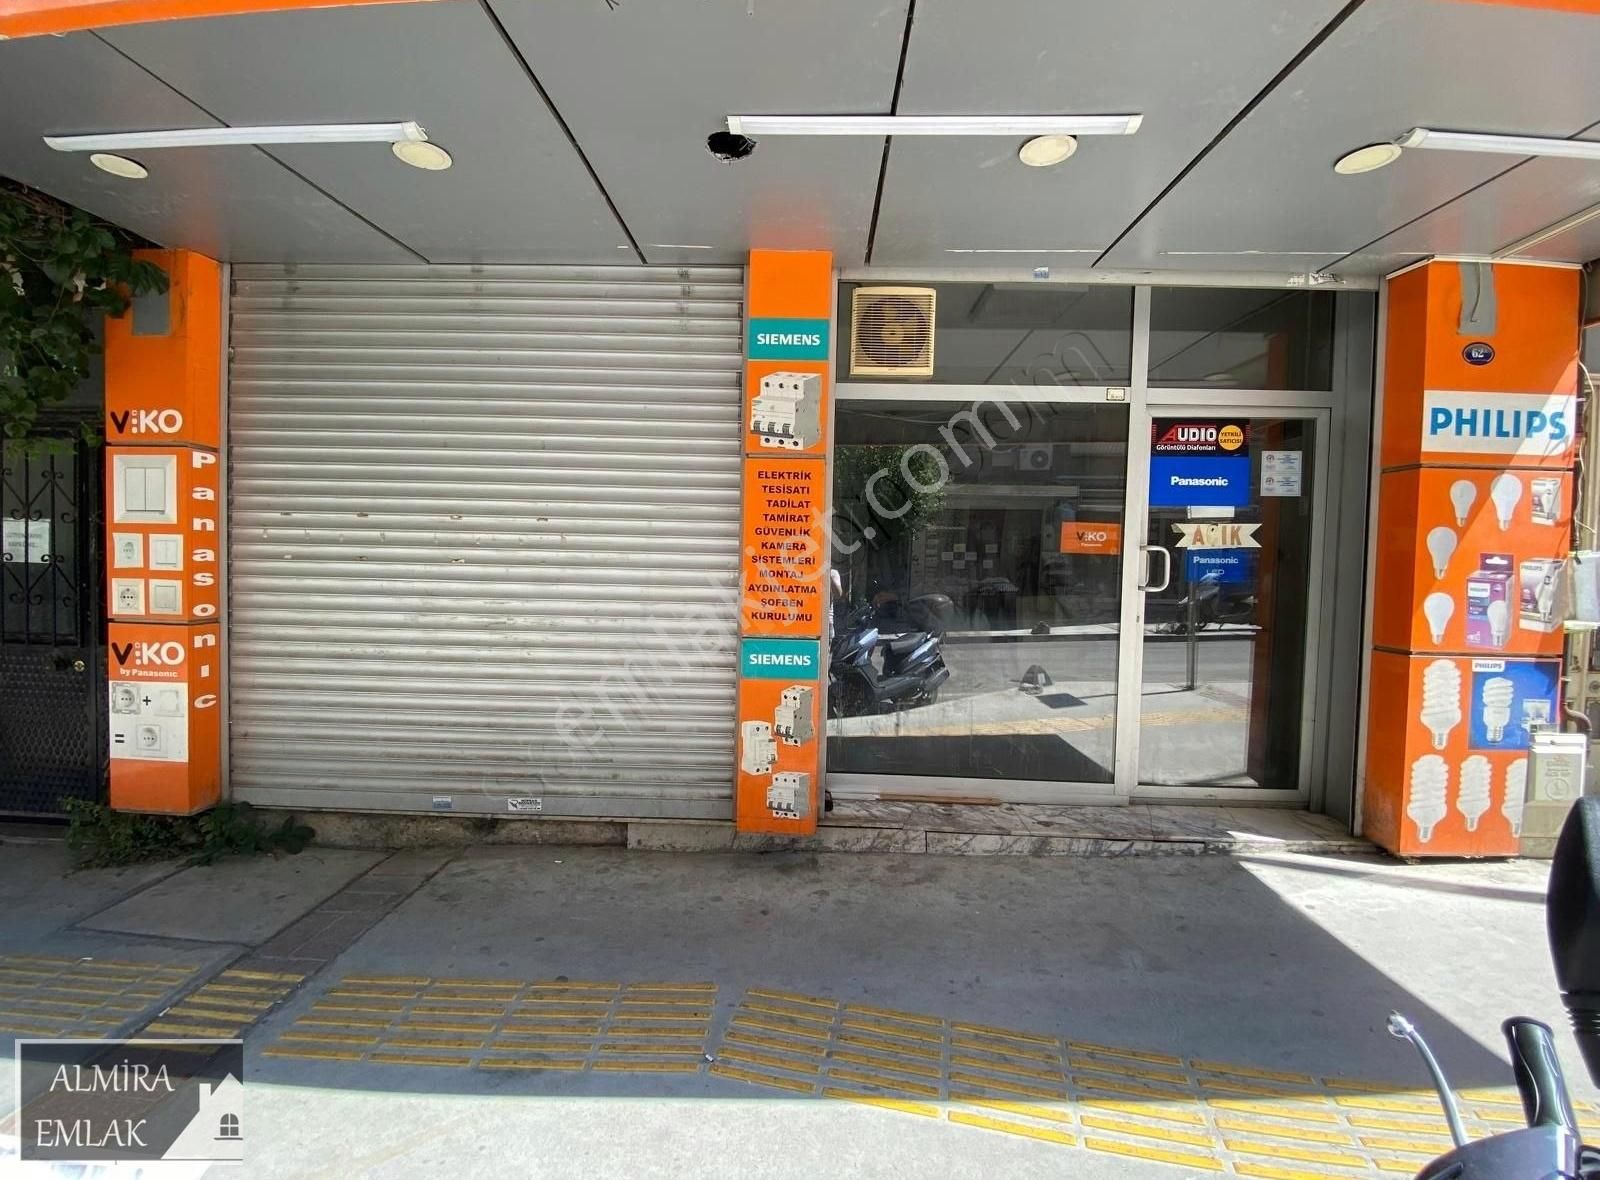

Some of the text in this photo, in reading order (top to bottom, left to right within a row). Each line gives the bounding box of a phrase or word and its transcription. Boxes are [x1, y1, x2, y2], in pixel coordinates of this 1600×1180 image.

[757, 333, 820, 346] SIEMENS
[1430, 407, 1567, 440] PHILIPS
[1162, 425, 1217, 443] AUDIO
[758, 470, 811, 480] ELEKTRİK
[1170, 476, 1229, 486] Panasonic
[762, 484, 810, 494] TESİSATI
[767, 499, 811, 508] TADİLAT
[763, 513, 810, 522] TAMİRAT
[755, 527, 810, 536] GÜVENLİK
[761, 541, 807, 551] KAMERA
[1193, 556, 1239, 564] Panasonic
[760, 570, 804, 578] MONTAJ
[192, 451, 216, 709] Panasonic
[748, 584, 817, 593] AYDINLATMA
[760, 598, 804, 608] ŞOFBEN
[751, 612, 813, 622] KURULUMU
[749, 654, 811, 666] SIEMENS
[120, 668, 178, 678] by Panasonic
